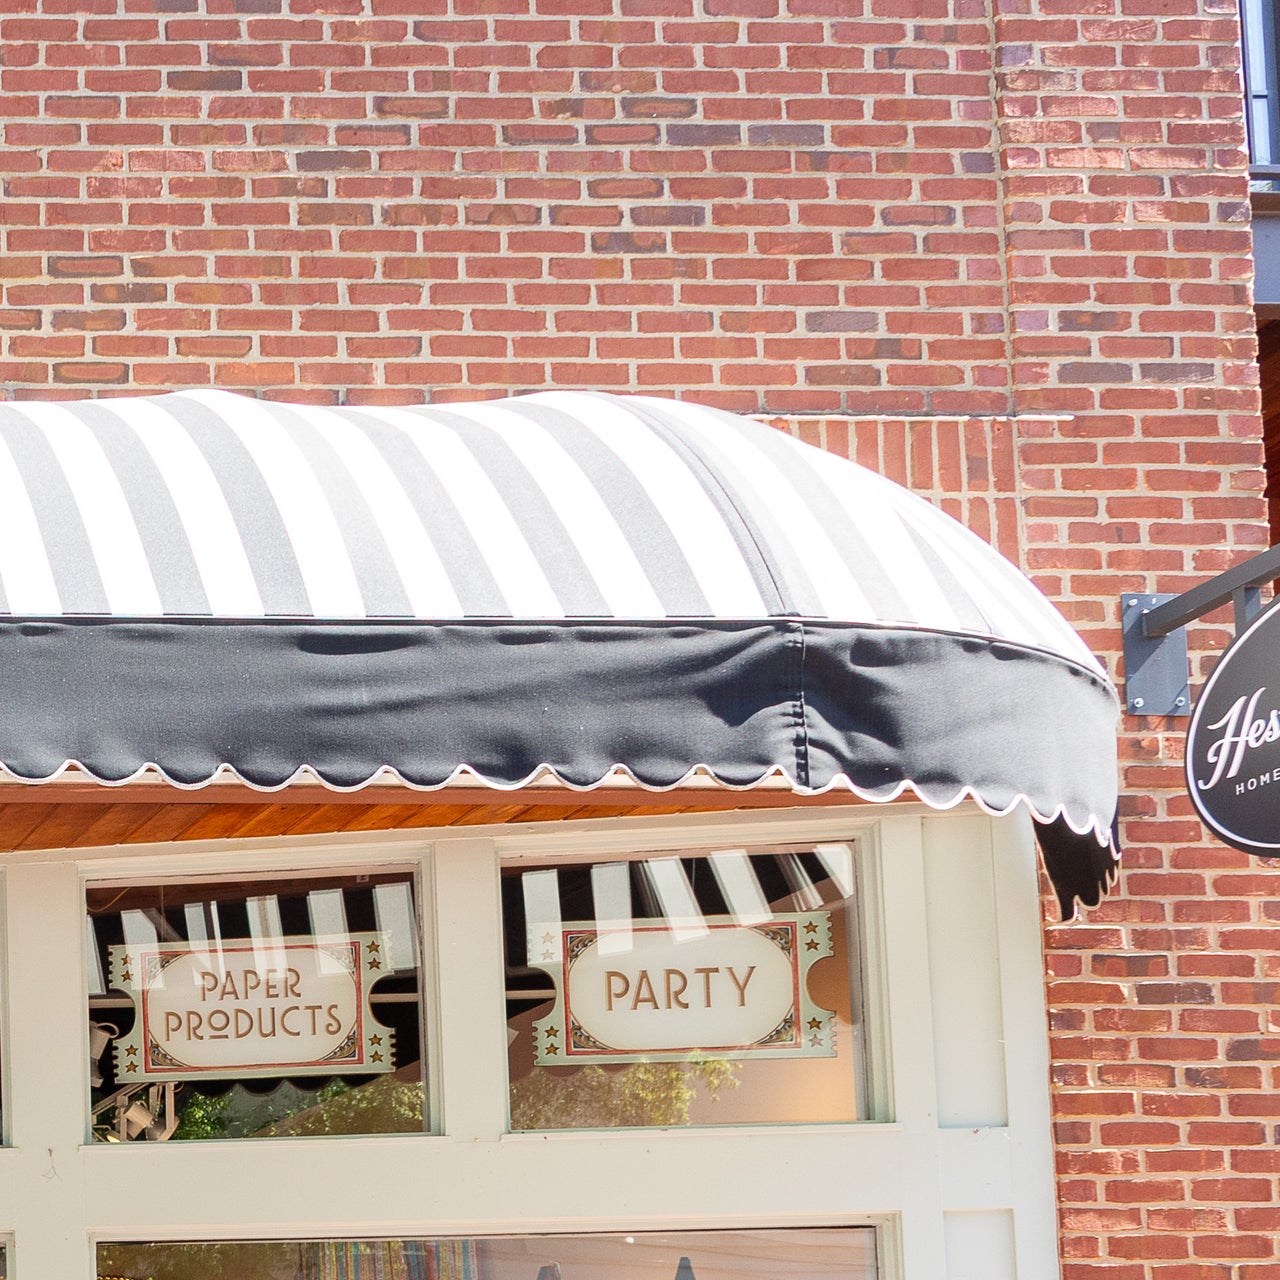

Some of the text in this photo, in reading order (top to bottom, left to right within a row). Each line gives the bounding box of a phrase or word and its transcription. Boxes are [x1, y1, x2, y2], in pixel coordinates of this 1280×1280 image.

[1197, 687, 1280, 790] Hes
[199, 967, 303, 1002] PAPER
[603, 965, 758, 1013] PARTY
[164, 1004, 343, 1043] PRODUCTS
